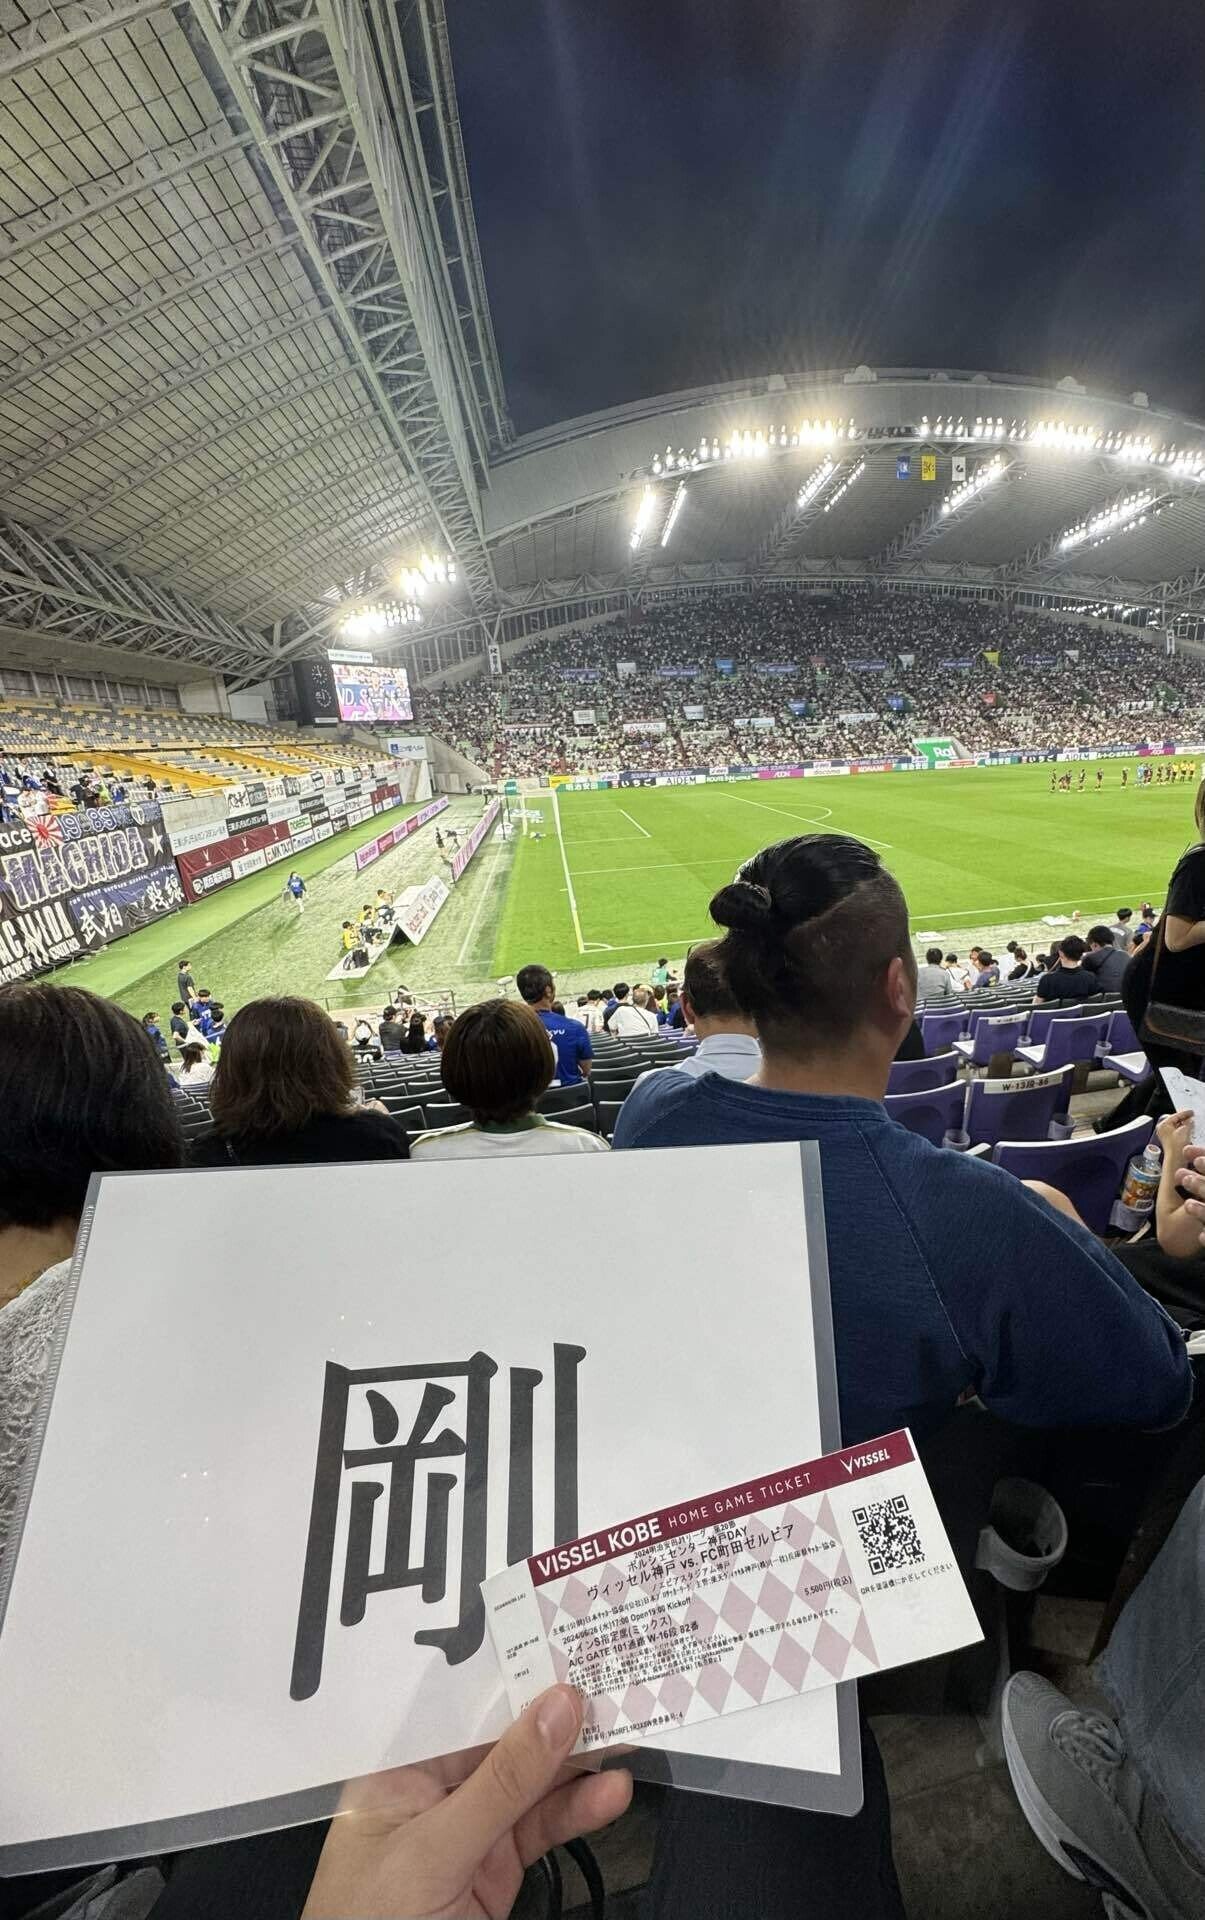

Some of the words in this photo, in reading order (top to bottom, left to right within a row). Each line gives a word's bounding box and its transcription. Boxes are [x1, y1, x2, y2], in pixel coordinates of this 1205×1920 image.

[86, 807, 117, 832] 89
[2, 826, 149, 911] MACHIDA
[853, 1446, 891, 1470] VISSEL
[290, 1342, 587, 1702] 剛
[537, 1537, 606, 1577] VISSEL
[606, 1517, 662, 1552] KOBE
[667, 1506, 708, 1530] HOME
[713, 1490, 755, 1514] GAME
[760, 1471, 813, 1499] TICKET
[586, 1560, 678, 1602] ヴィッセル神戸
[679, 1555, 698, 1571] vs.
[699, 1522, 797, 1566] FC町田ゼルビア
[626, 1524, 749, 1574] ポルシェセンター神戸DAY
[665, 1595, 692, 1610] Kickoff
[567, 1655, 584, 1668] A/C
[584, 1647, 611, 1663] GATE
